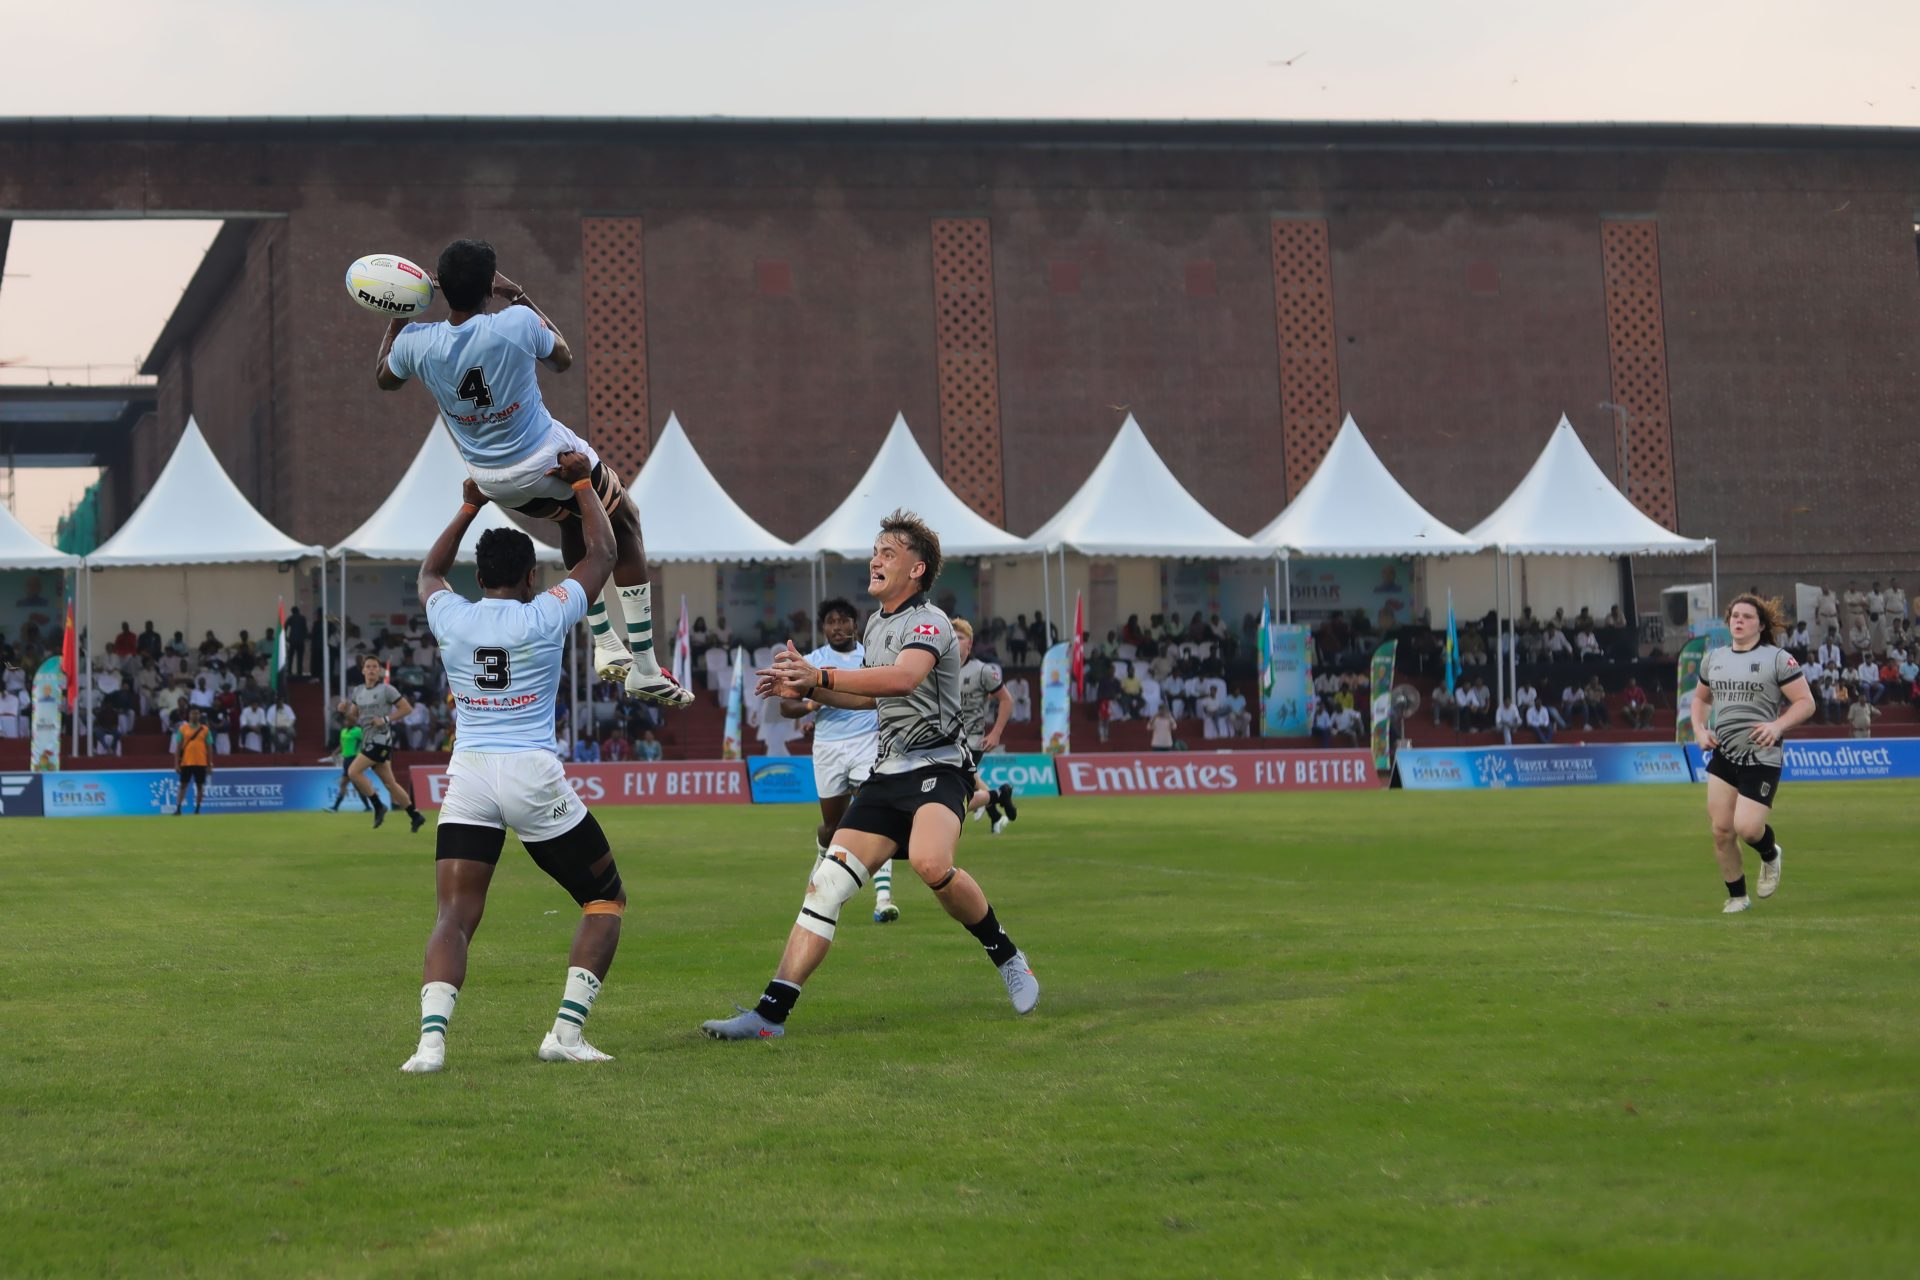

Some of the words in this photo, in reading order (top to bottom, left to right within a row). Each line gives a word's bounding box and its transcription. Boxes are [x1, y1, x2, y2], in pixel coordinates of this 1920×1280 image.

[358, 289, 416, 311] RHINO
[456, 366, 495, 409] 4
[474, 646, 511, 691] 3
[1710, 679, 1764, 692] Emirates
[457, 693, 488, 706] HOME
[493, 693, 538, 707] LANDS
[1728, 692, 1755, 702] BETTER
[1783, 746, 1892, 767] rhino.direct
[1068, 760, 1237, 791] Emirates
[1255, 760, 1286, 784] FLY
[1295, 759, 1366, 783] BETTER
[1791, 767, 1820, 776] OFFICIAL
[1821, 767, 1839, 776] BALL
[1840, 767, 1849, 775] OF
[1850, 766, 1866, 775] ASIA
[234, 783, 283, 797] सरकार
[624, 772, 658, 796] FLY
[666, 771, 741, 796] BETTER
